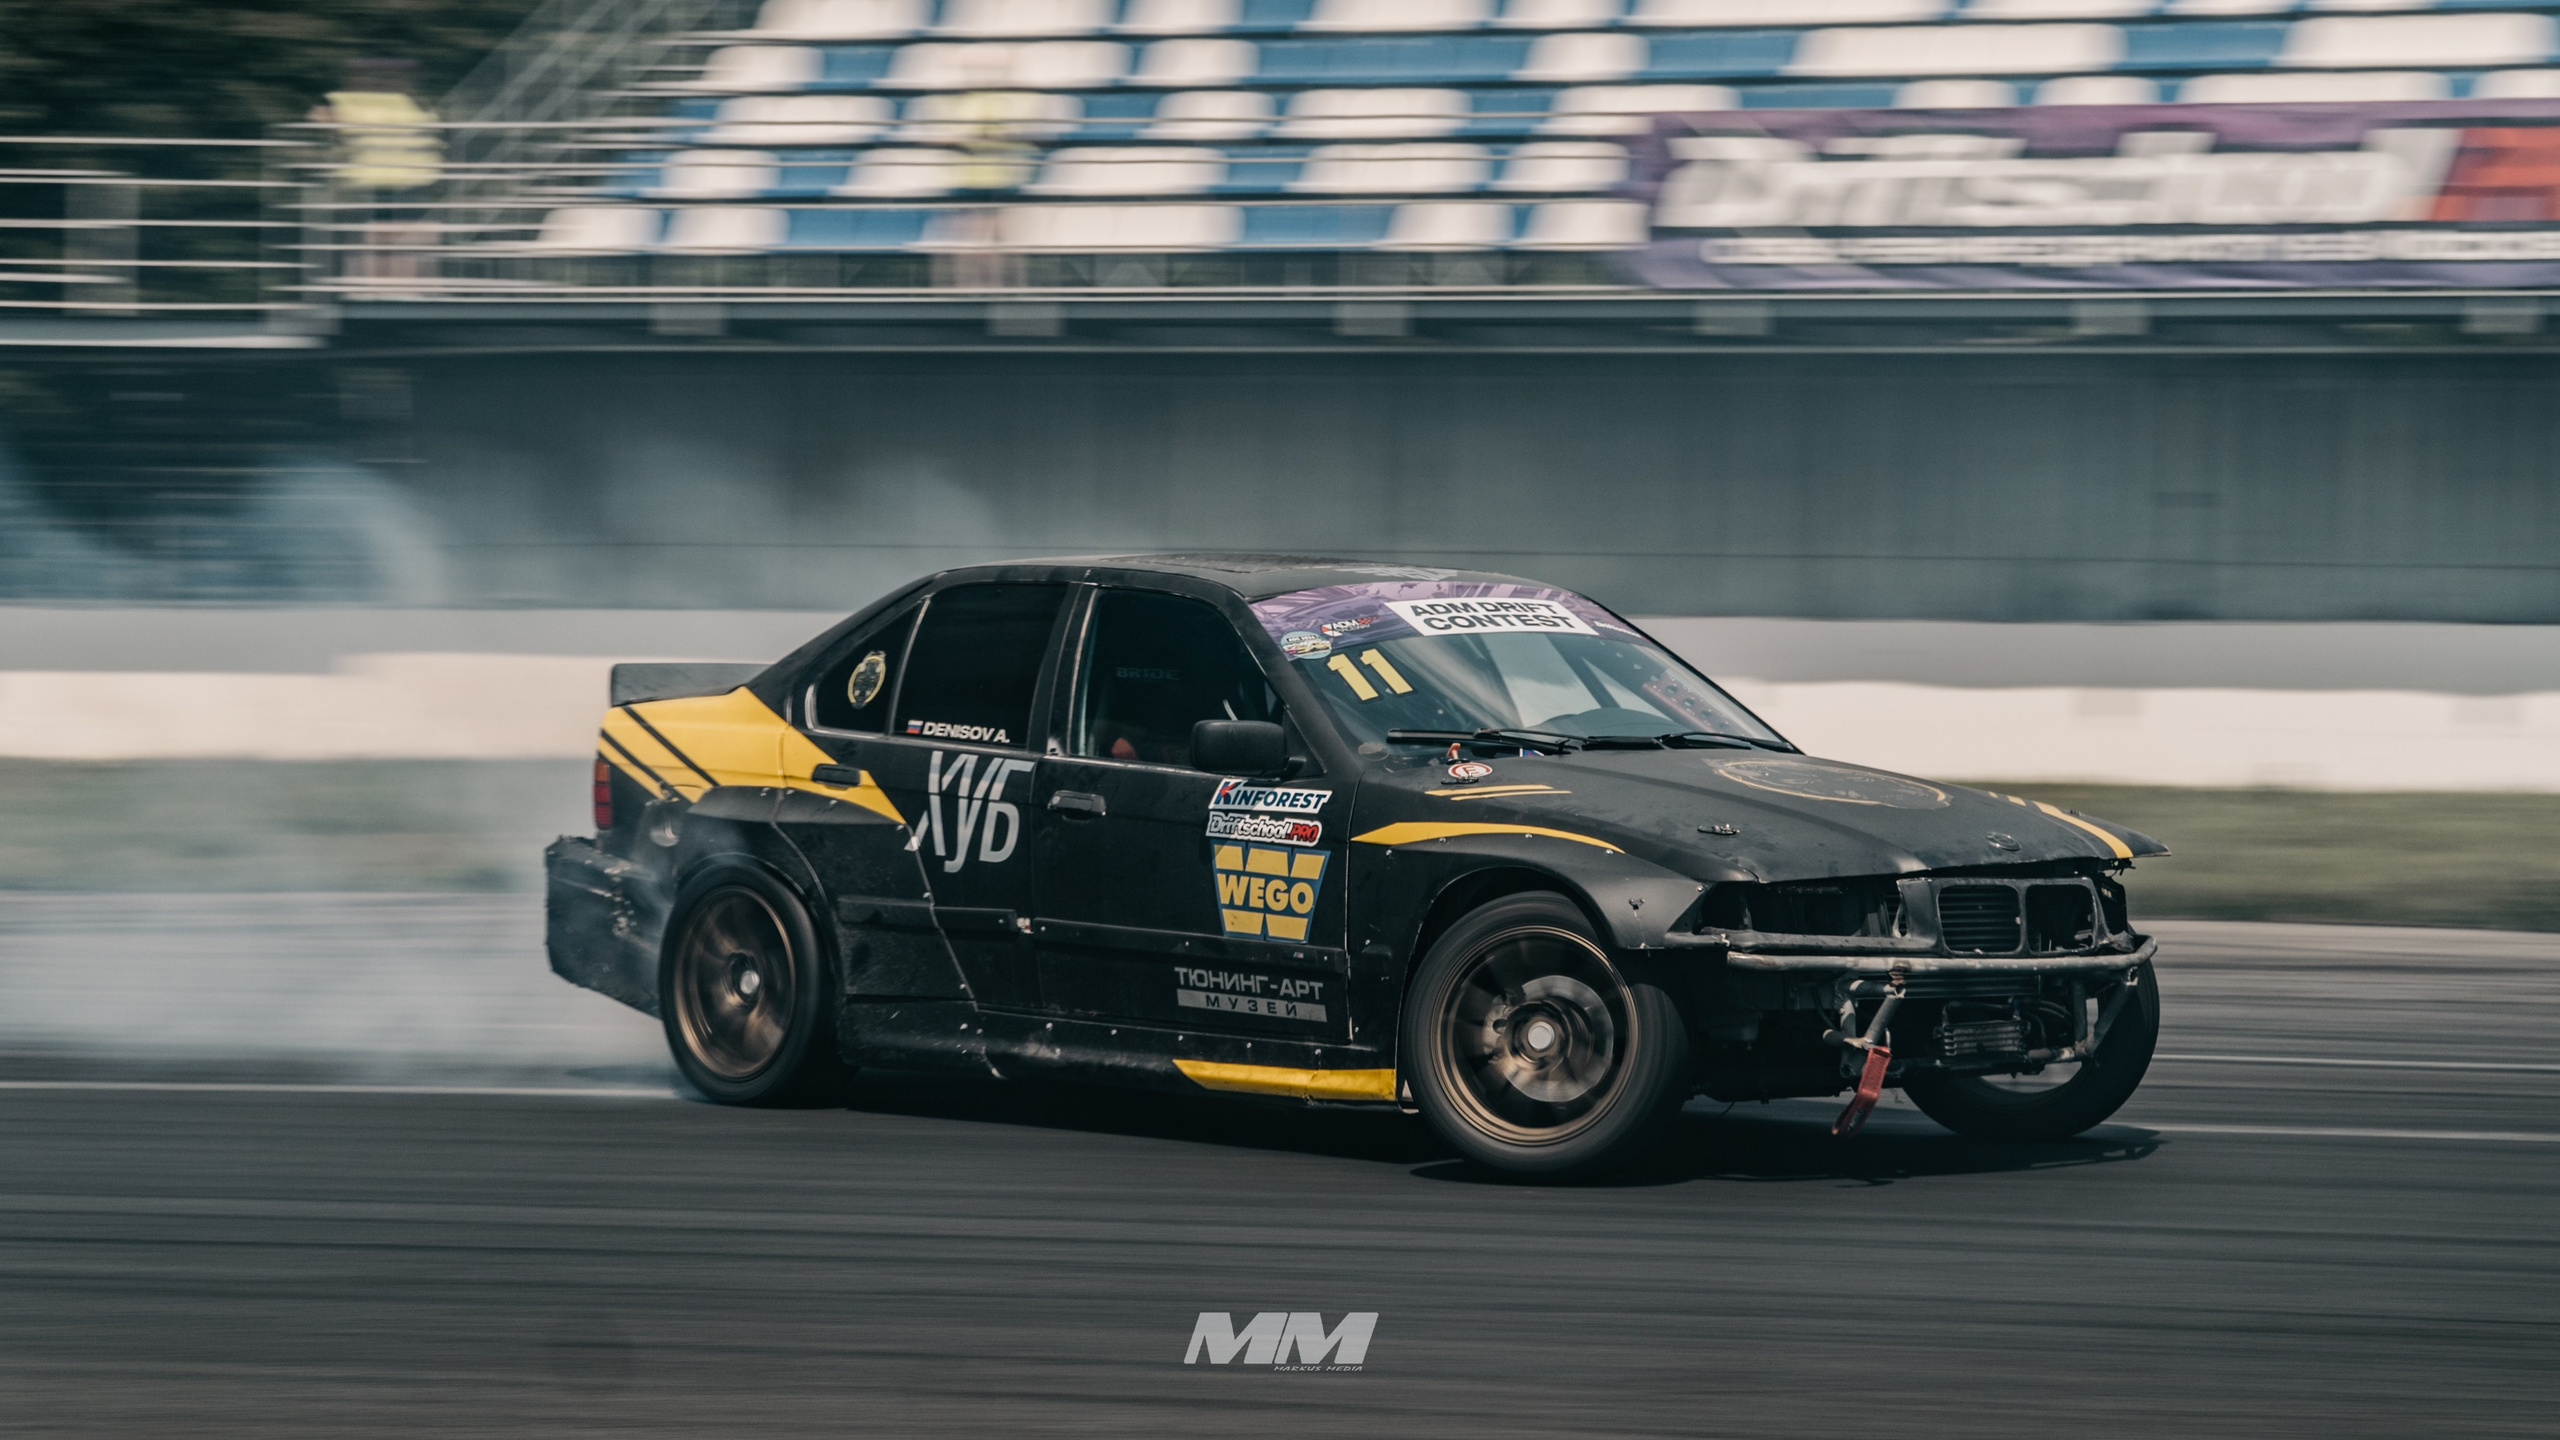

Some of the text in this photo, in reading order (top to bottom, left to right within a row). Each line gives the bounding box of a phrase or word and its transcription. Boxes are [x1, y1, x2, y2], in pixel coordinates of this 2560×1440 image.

[1410, 602, 1559, 617] ADM DRIFT
[1423, 614, 1576, 630] CONTEST
[1115, 667, 1181, 680] BRIDE
[1326, 648, 1413, 701] 11
[923, 722, 1010, 743] DENISOV A.
[1214, 781, 1327, 809] KINFOREST
[1217, 873, 1314, 914] WEGO
[1174, 967, 1323, 1000] ТЮНИНГ-АРТ
[1205, 994, 1297, 1017] МУЗЕЙ
